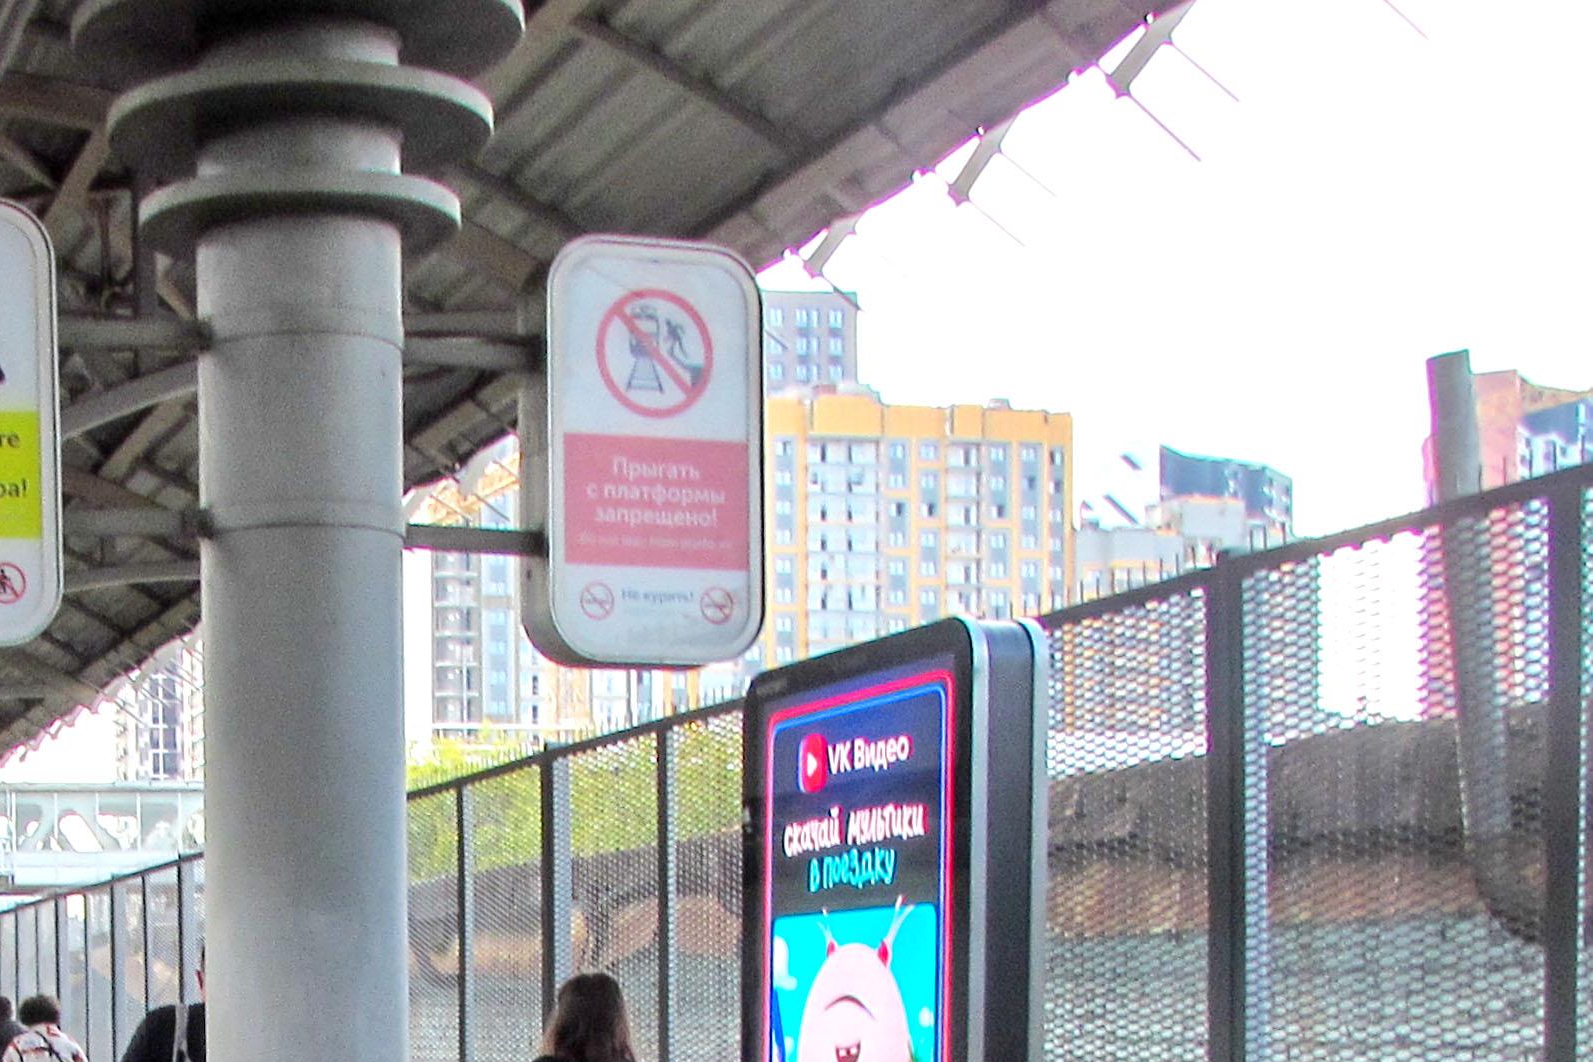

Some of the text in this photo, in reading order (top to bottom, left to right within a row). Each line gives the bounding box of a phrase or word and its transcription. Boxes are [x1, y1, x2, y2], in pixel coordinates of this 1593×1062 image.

[612, 456, 700, 481] Прыгать
[586, 484, 727, 506] с платформы
[594, 506, 718, 529] запрещено!
[827, 734, 911, 775] VK Видео
